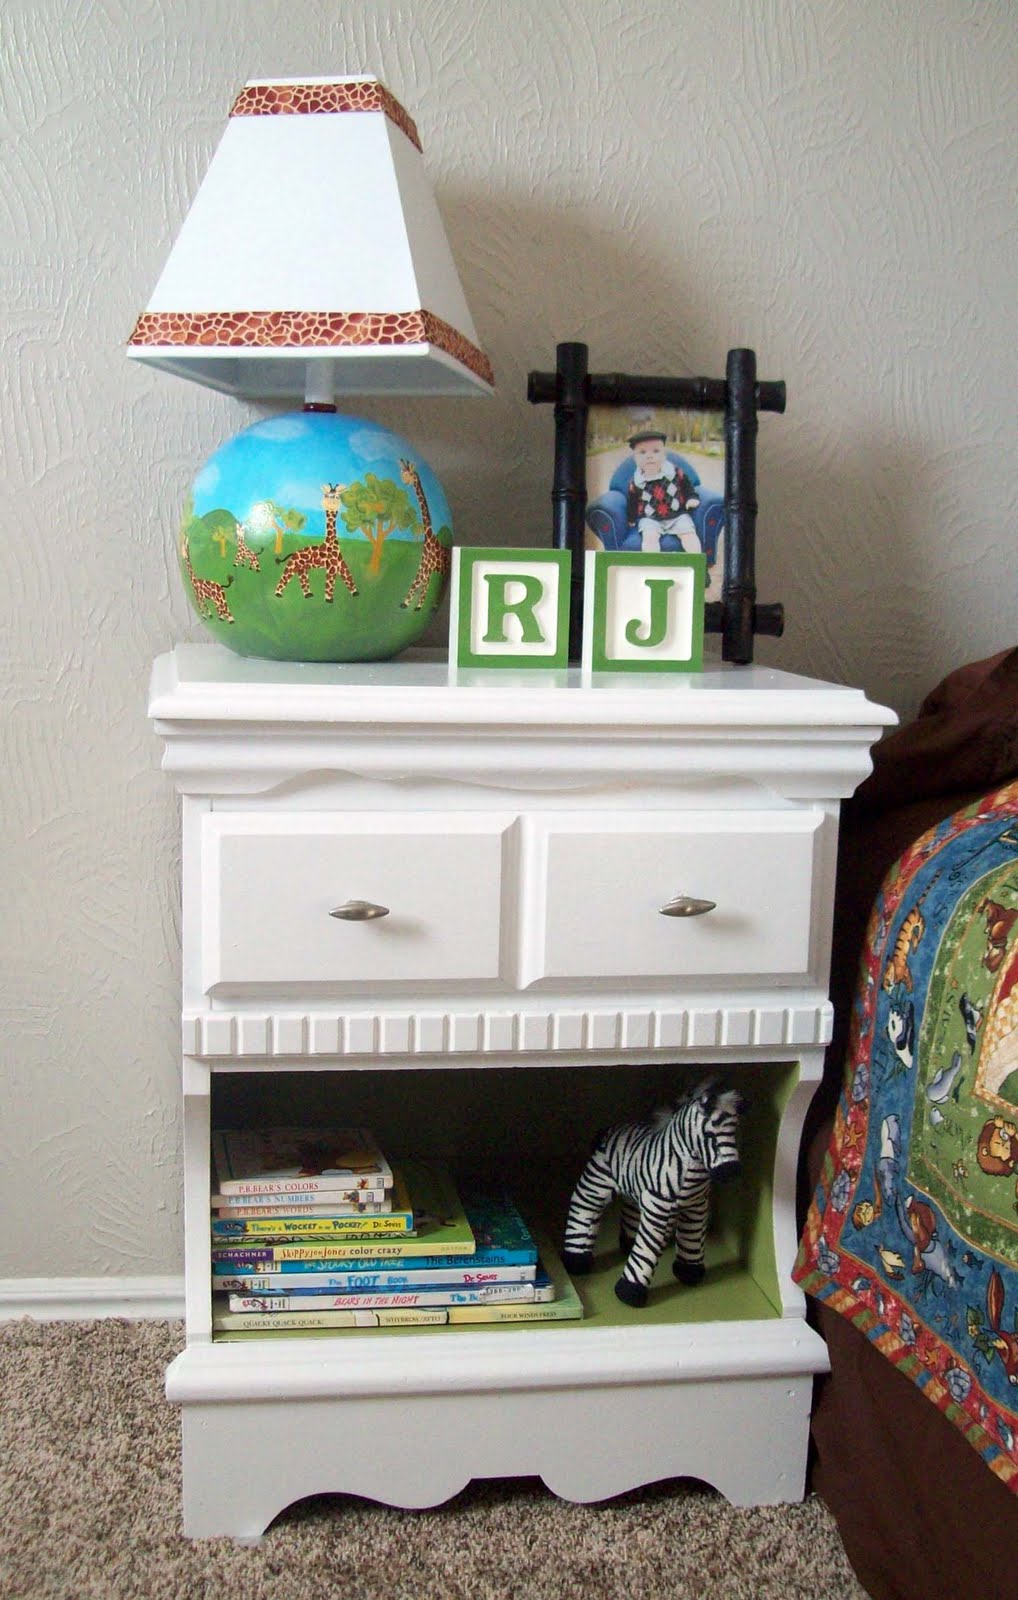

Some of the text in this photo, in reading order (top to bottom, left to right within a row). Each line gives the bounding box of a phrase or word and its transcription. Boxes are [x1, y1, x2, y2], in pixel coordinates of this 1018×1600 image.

[482, 574, 545, 643] R
[625, 579, 675, 647] J
[284, 1182, 319, 1191] COLORS
[274, 1194, 315, 1202] NUMBERS
[282, 1206, 314, 1214] WORDS
[283, 1222, 318, 1231] WOCKET
[350, 1246, 374, 1255] color
[377, 1247, 402, 1255] crazy
[358, 1259, 377, 1268] OLD
[426, 1254, 505, 1265] The Berenstains
[347, 1275, 380, 1288] FOOT
[476, 1273, 498, 1282] Seuss
[334, 1297, 360, 1306] BEARS
[363, 1297, 372, 1305] IN
[391, 1295, 419, 1305] NIGHT
